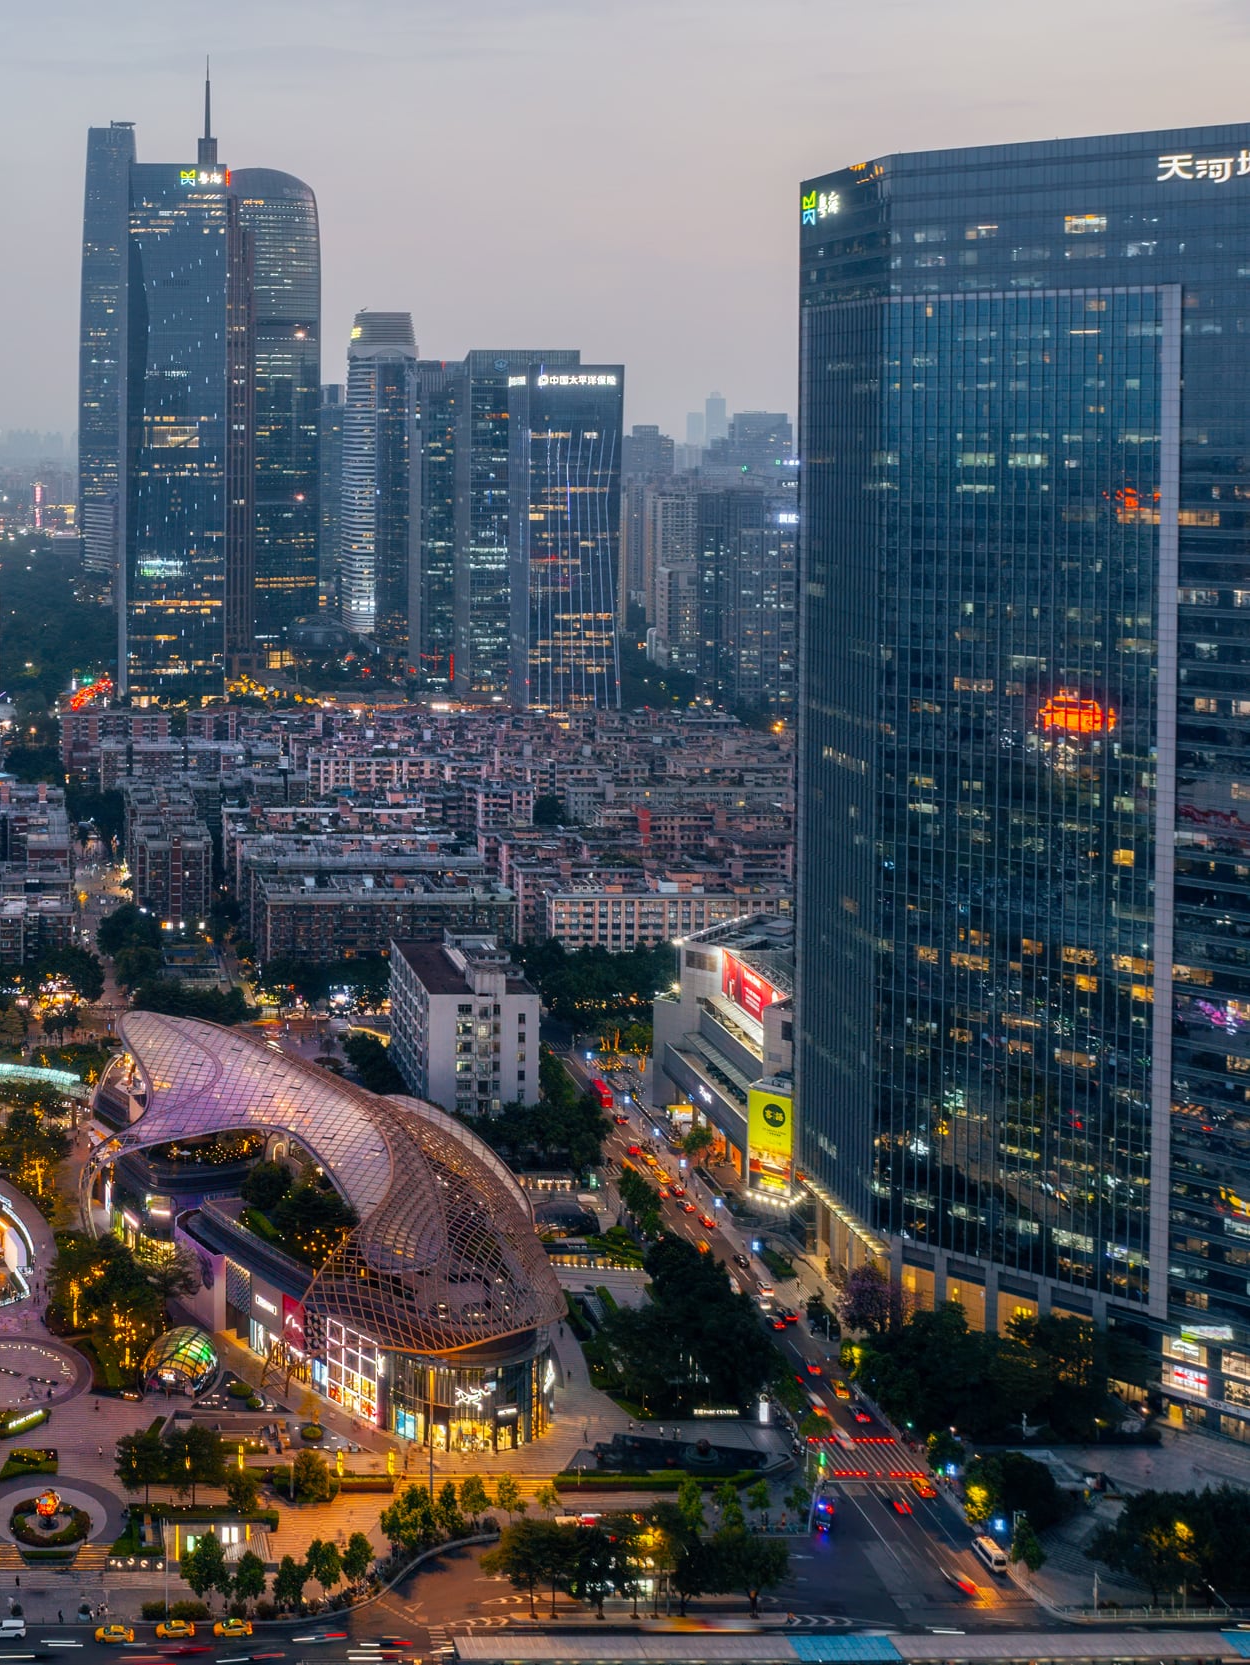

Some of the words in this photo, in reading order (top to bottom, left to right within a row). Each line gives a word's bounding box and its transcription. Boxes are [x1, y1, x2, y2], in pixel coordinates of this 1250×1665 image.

[549, 375, 616, 386] 中国太平洋保险
